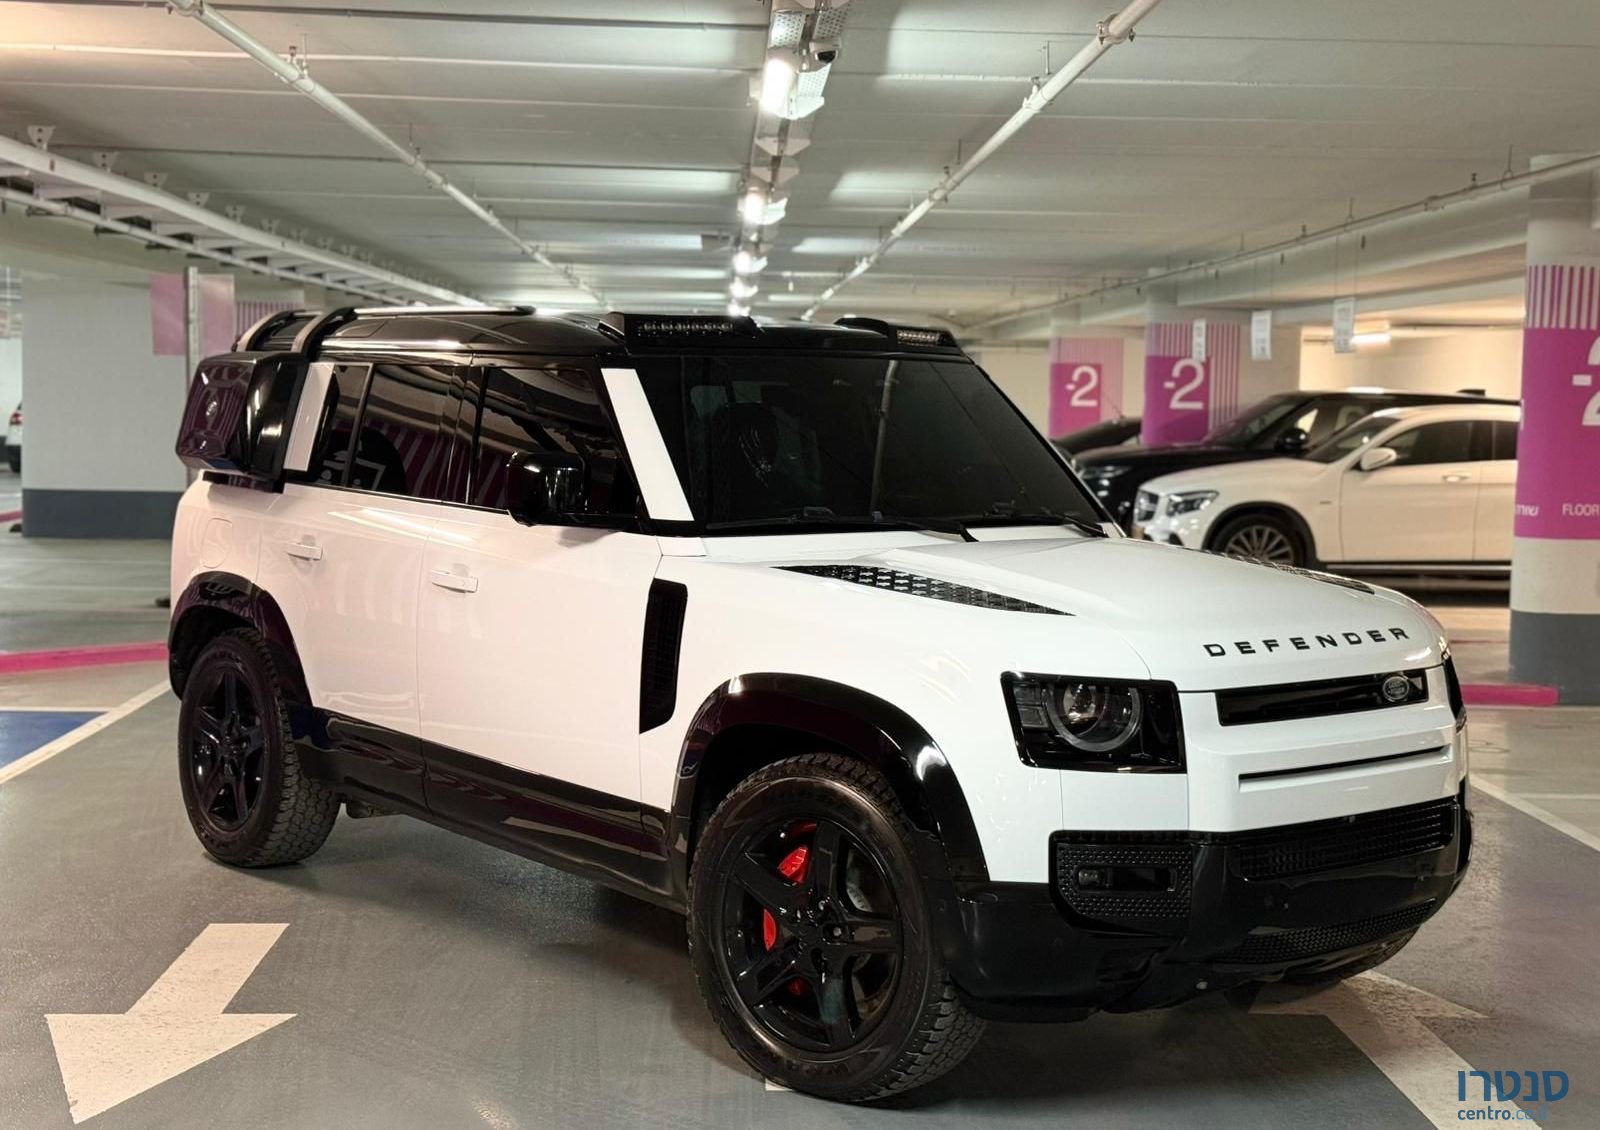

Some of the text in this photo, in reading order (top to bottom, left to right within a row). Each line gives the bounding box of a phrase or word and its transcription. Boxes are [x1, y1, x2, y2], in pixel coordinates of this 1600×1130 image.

[1065, 365, 1099, 407] -2
[1163, 358, 1205, 410] -2
[1203, 627, 1410, 657] DEFENDER
